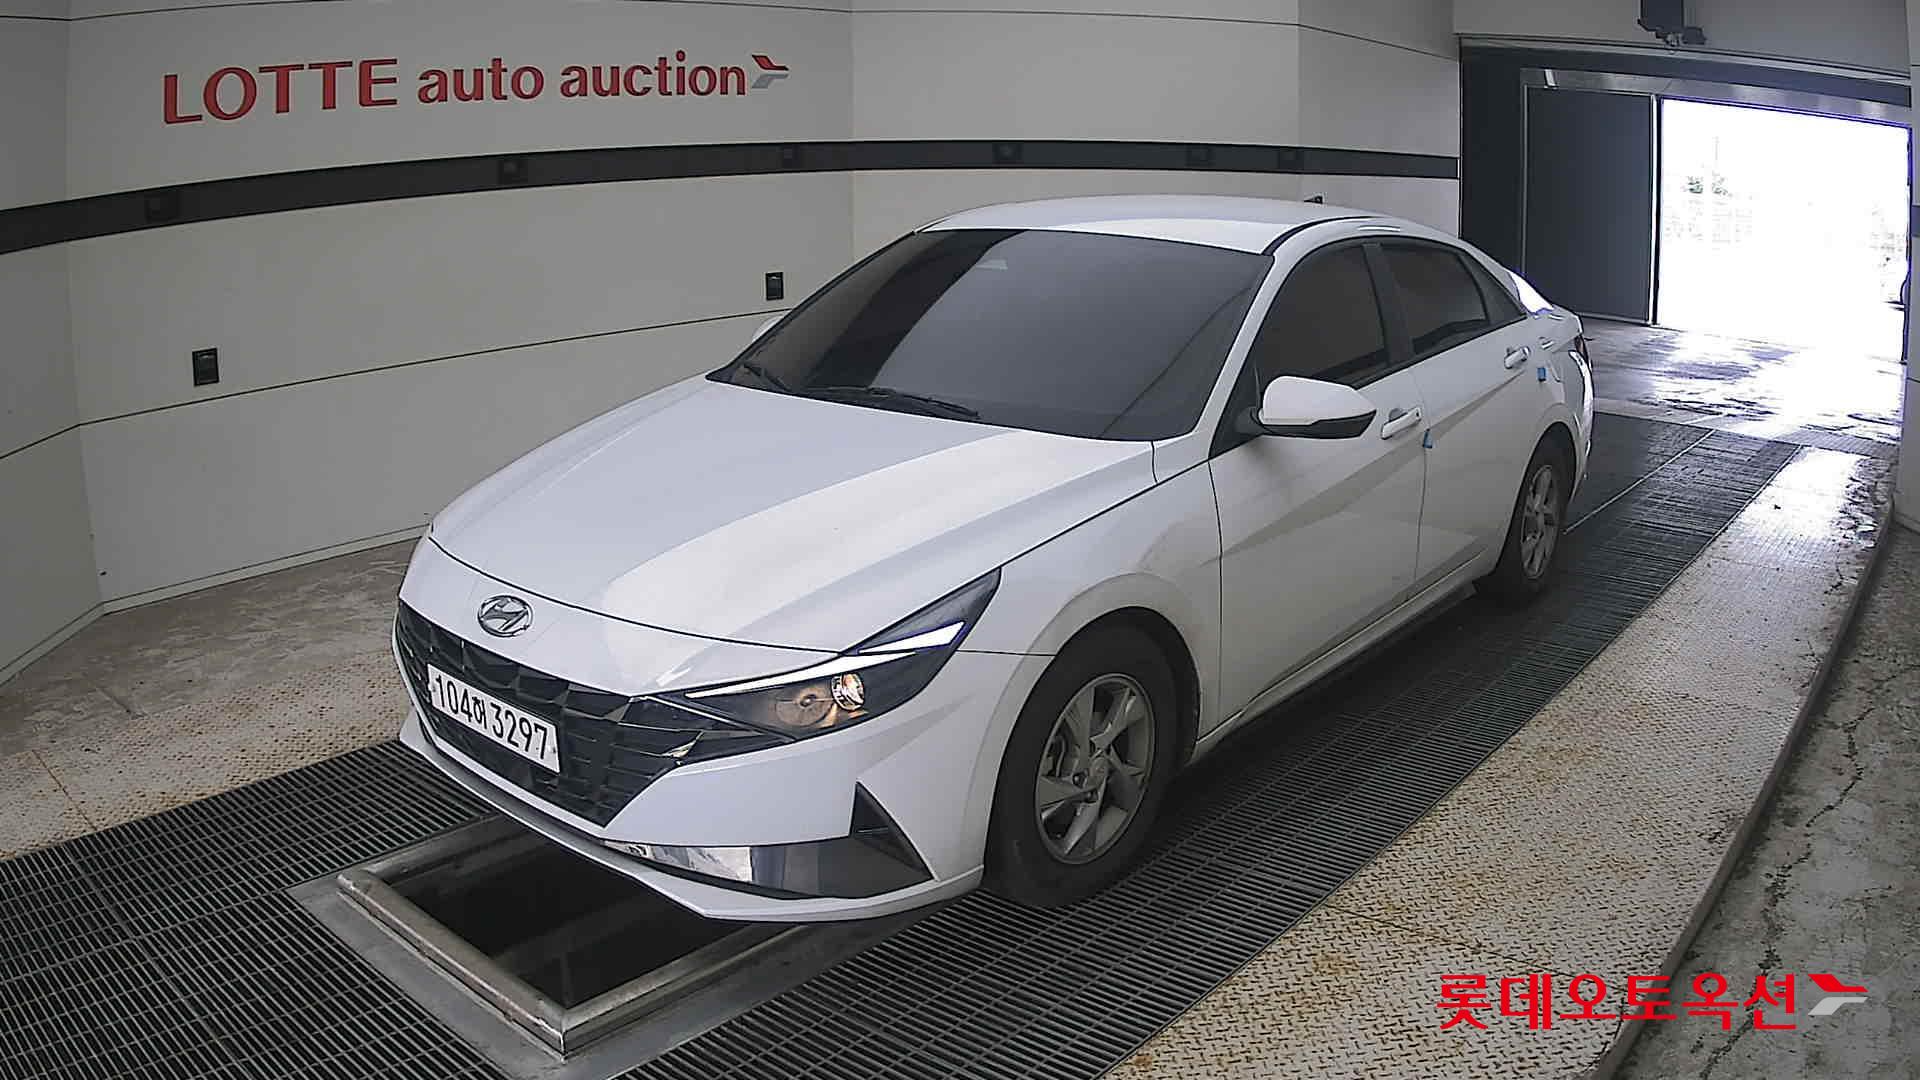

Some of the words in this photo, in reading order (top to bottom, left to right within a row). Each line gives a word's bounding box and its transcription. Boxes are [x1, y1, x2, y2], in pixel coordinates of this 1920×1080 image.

[163, 58, 398, 125] LOTTE
[417, 57, 545, 103] auto
[559, 50, 747, 98] auction
